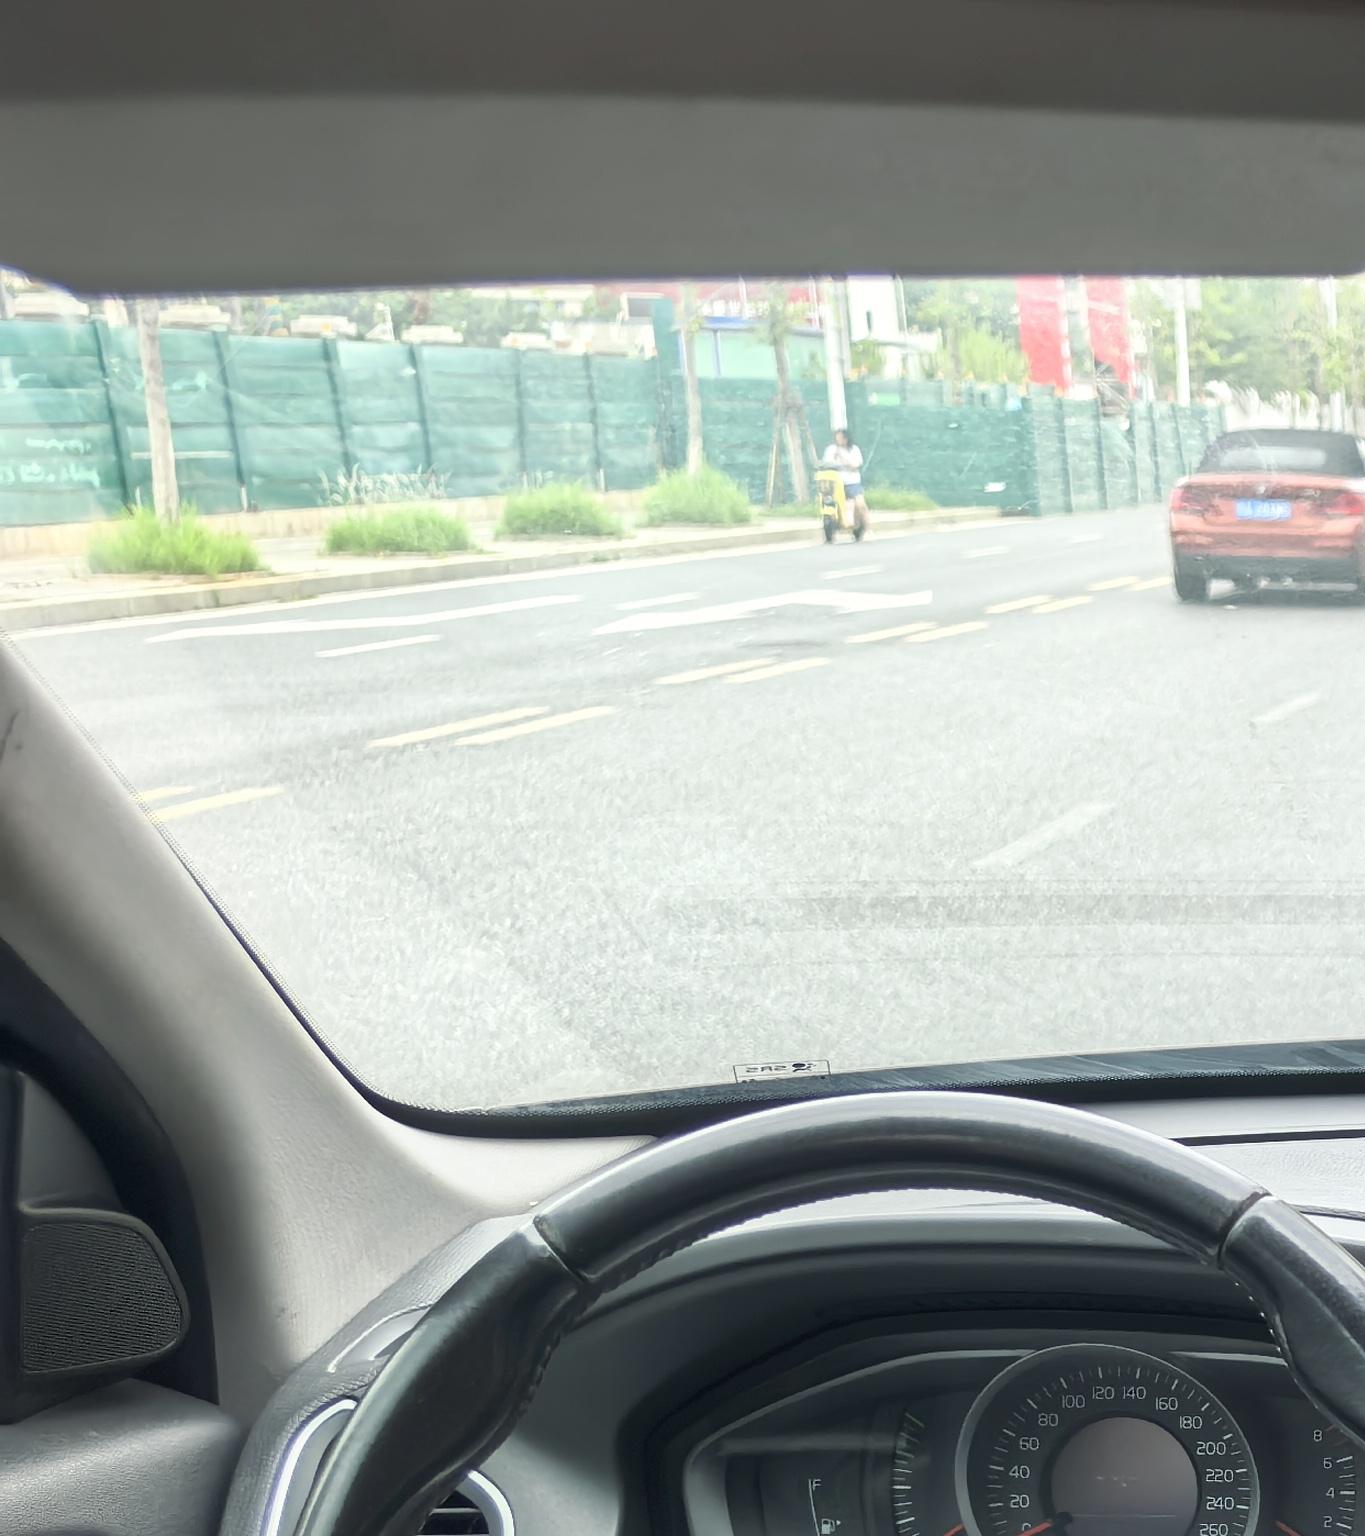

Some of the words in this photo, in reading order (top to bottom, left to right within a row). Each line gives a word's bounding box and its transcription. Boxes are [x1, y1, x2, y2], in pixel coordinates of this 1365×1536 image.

[1092, 1386, 1115, 1400] 120
[1122, 1386, 1147, 1400] 140
[1062, 1395, 1086, 1409] 100
[1155, 1397, 1178, 1411] 160
[1038, 1413, 1058, 1427] 80
[1179, 1416, 1202, 1430] 180
[1313, 1430, 1322, 1442] 8
[1020, 1437, 1040, 1451] 60
[1196, 1441, 1226, 1456] 200
[1324, 1458, 1333, 1469] 6
[1009, 1465, 1030, 1480] 40
[1206, 1468, 1234, 1482] 220
[812, 1478, 822, 1490] F
[1326, 1488, 1334, 1499] 4
[1010, 1494, 1030, 1508] 20
[1206, 1496, 1234, 1510] 240
[1323, 1516, 1332, 1528] 2
[1199, 1524, 1228, 1536] 260
